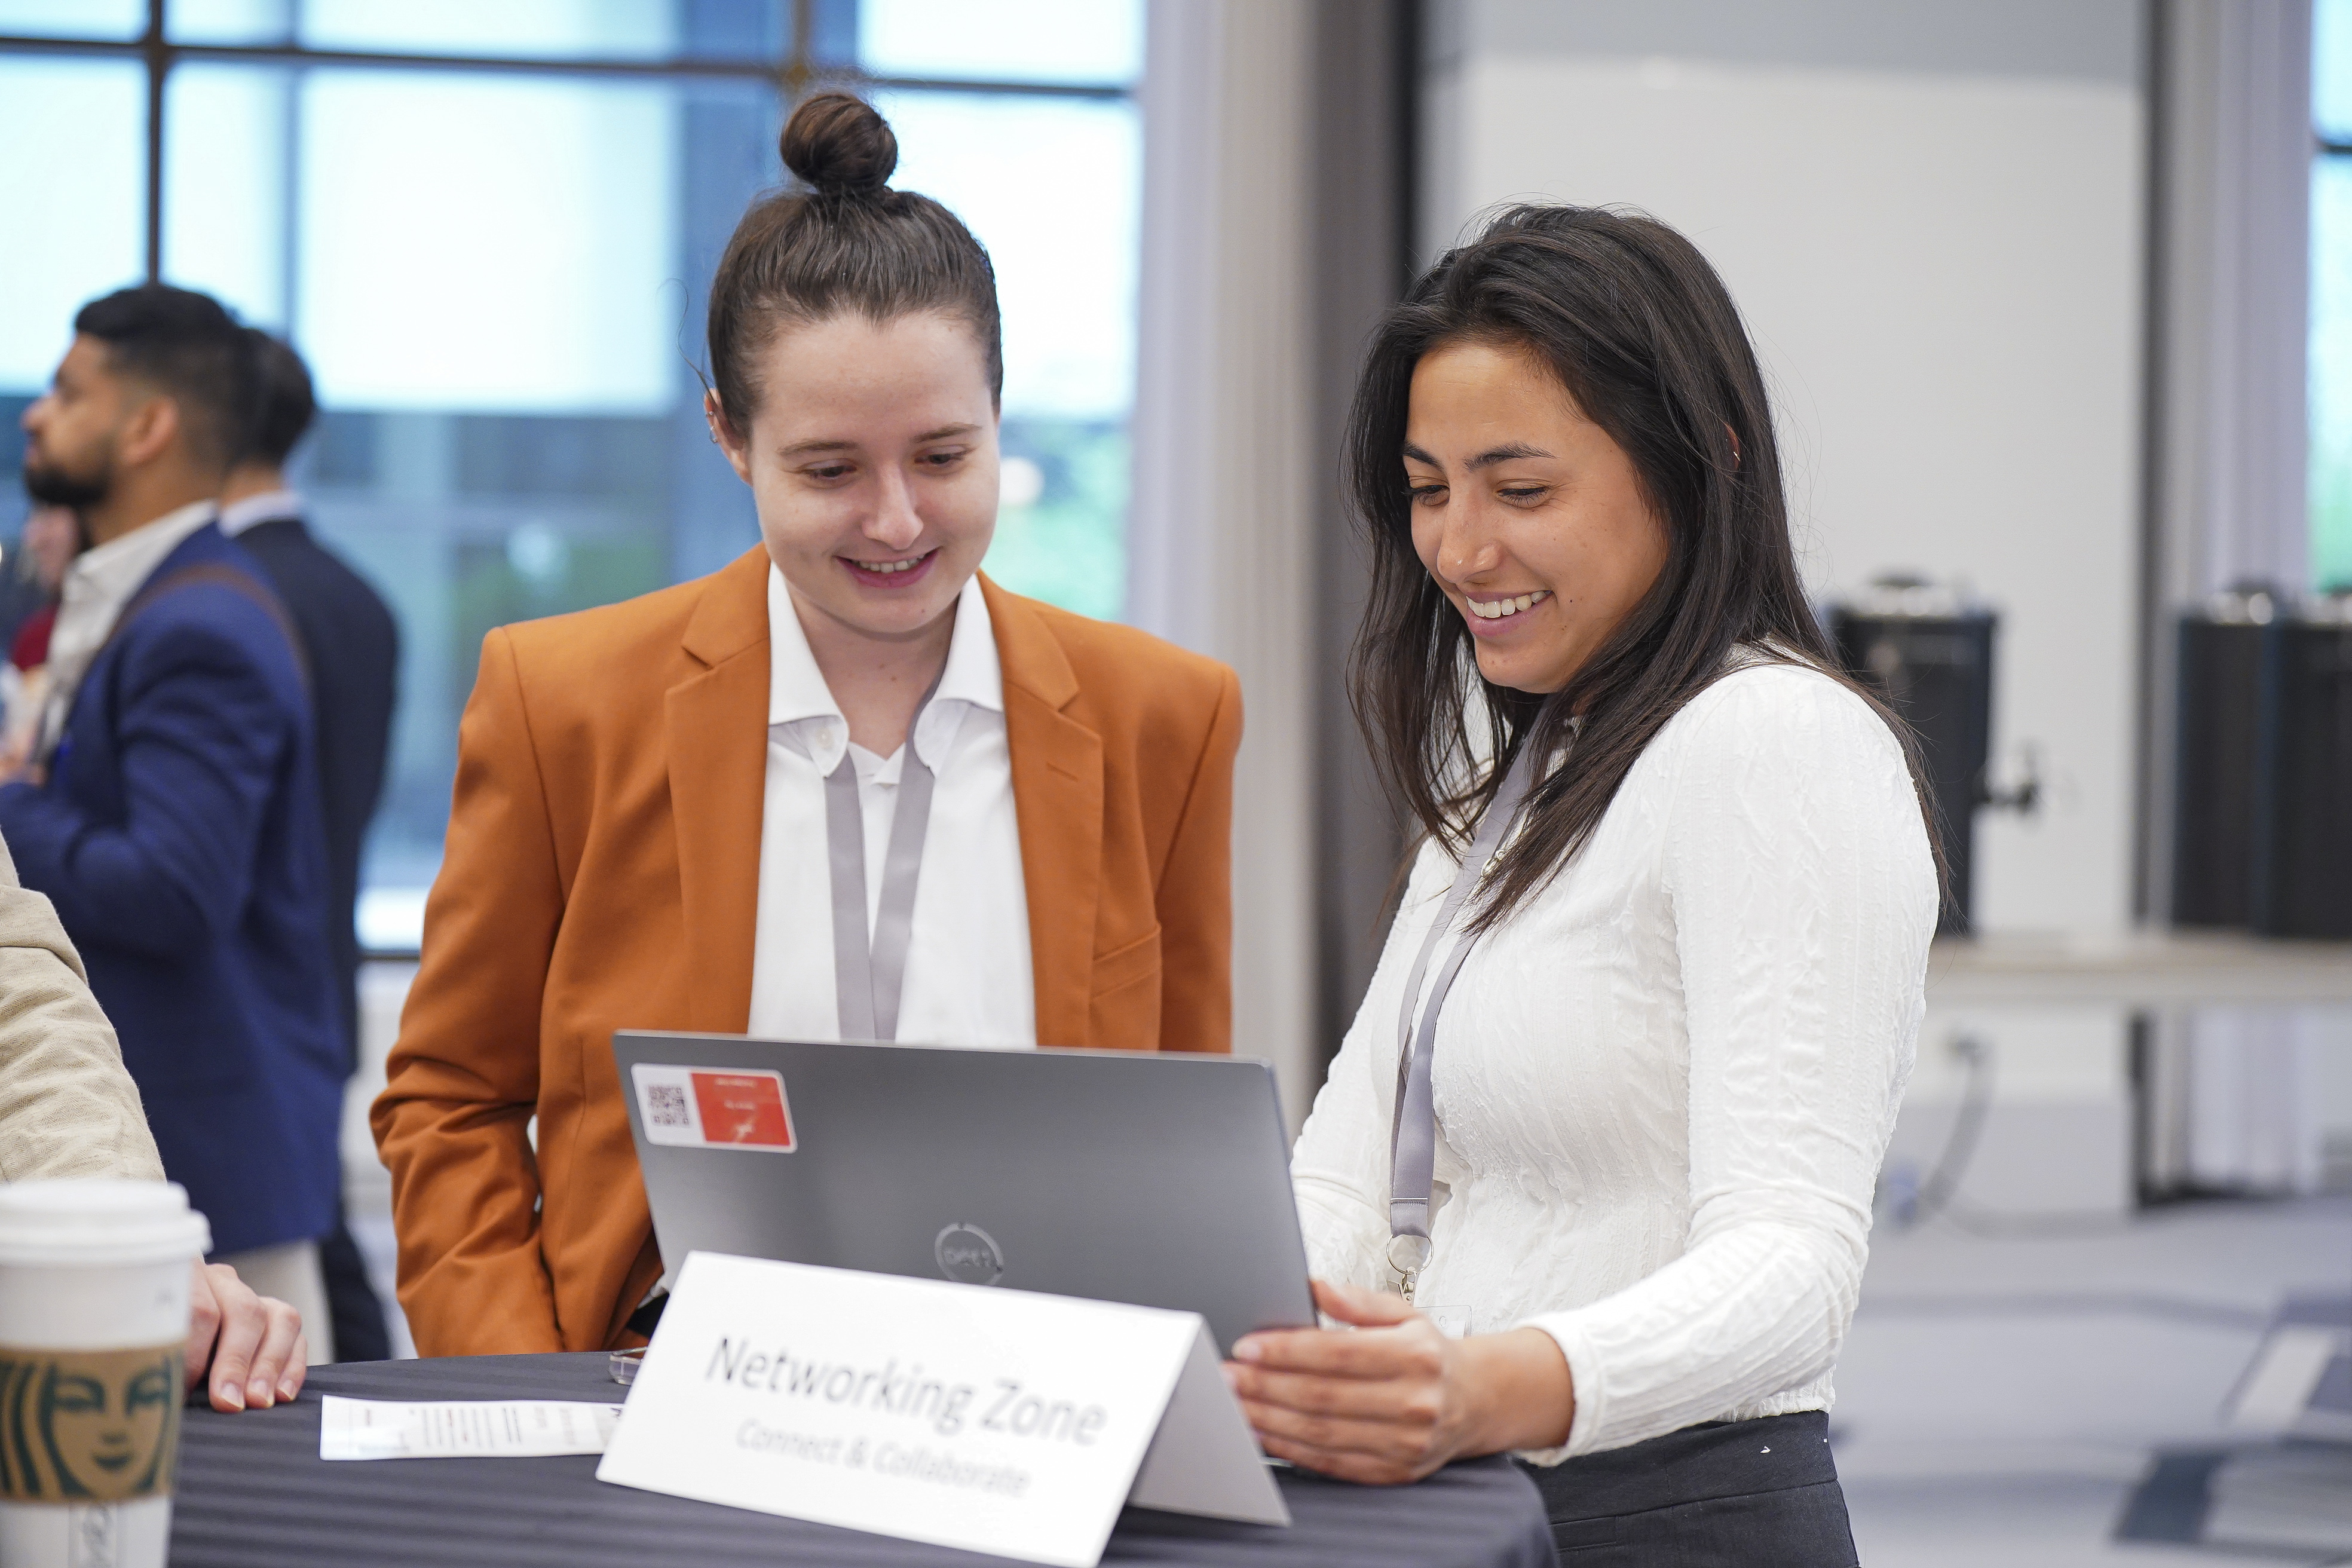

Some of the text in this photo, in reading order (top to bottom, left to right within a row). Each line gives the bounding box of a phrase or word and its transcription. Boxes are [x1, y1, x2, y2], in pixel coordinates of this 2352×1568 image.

[705, 1336, 1107, 1447] Networking Zone
[735, 1418, 1032, 1497] Connect & Collaborate
